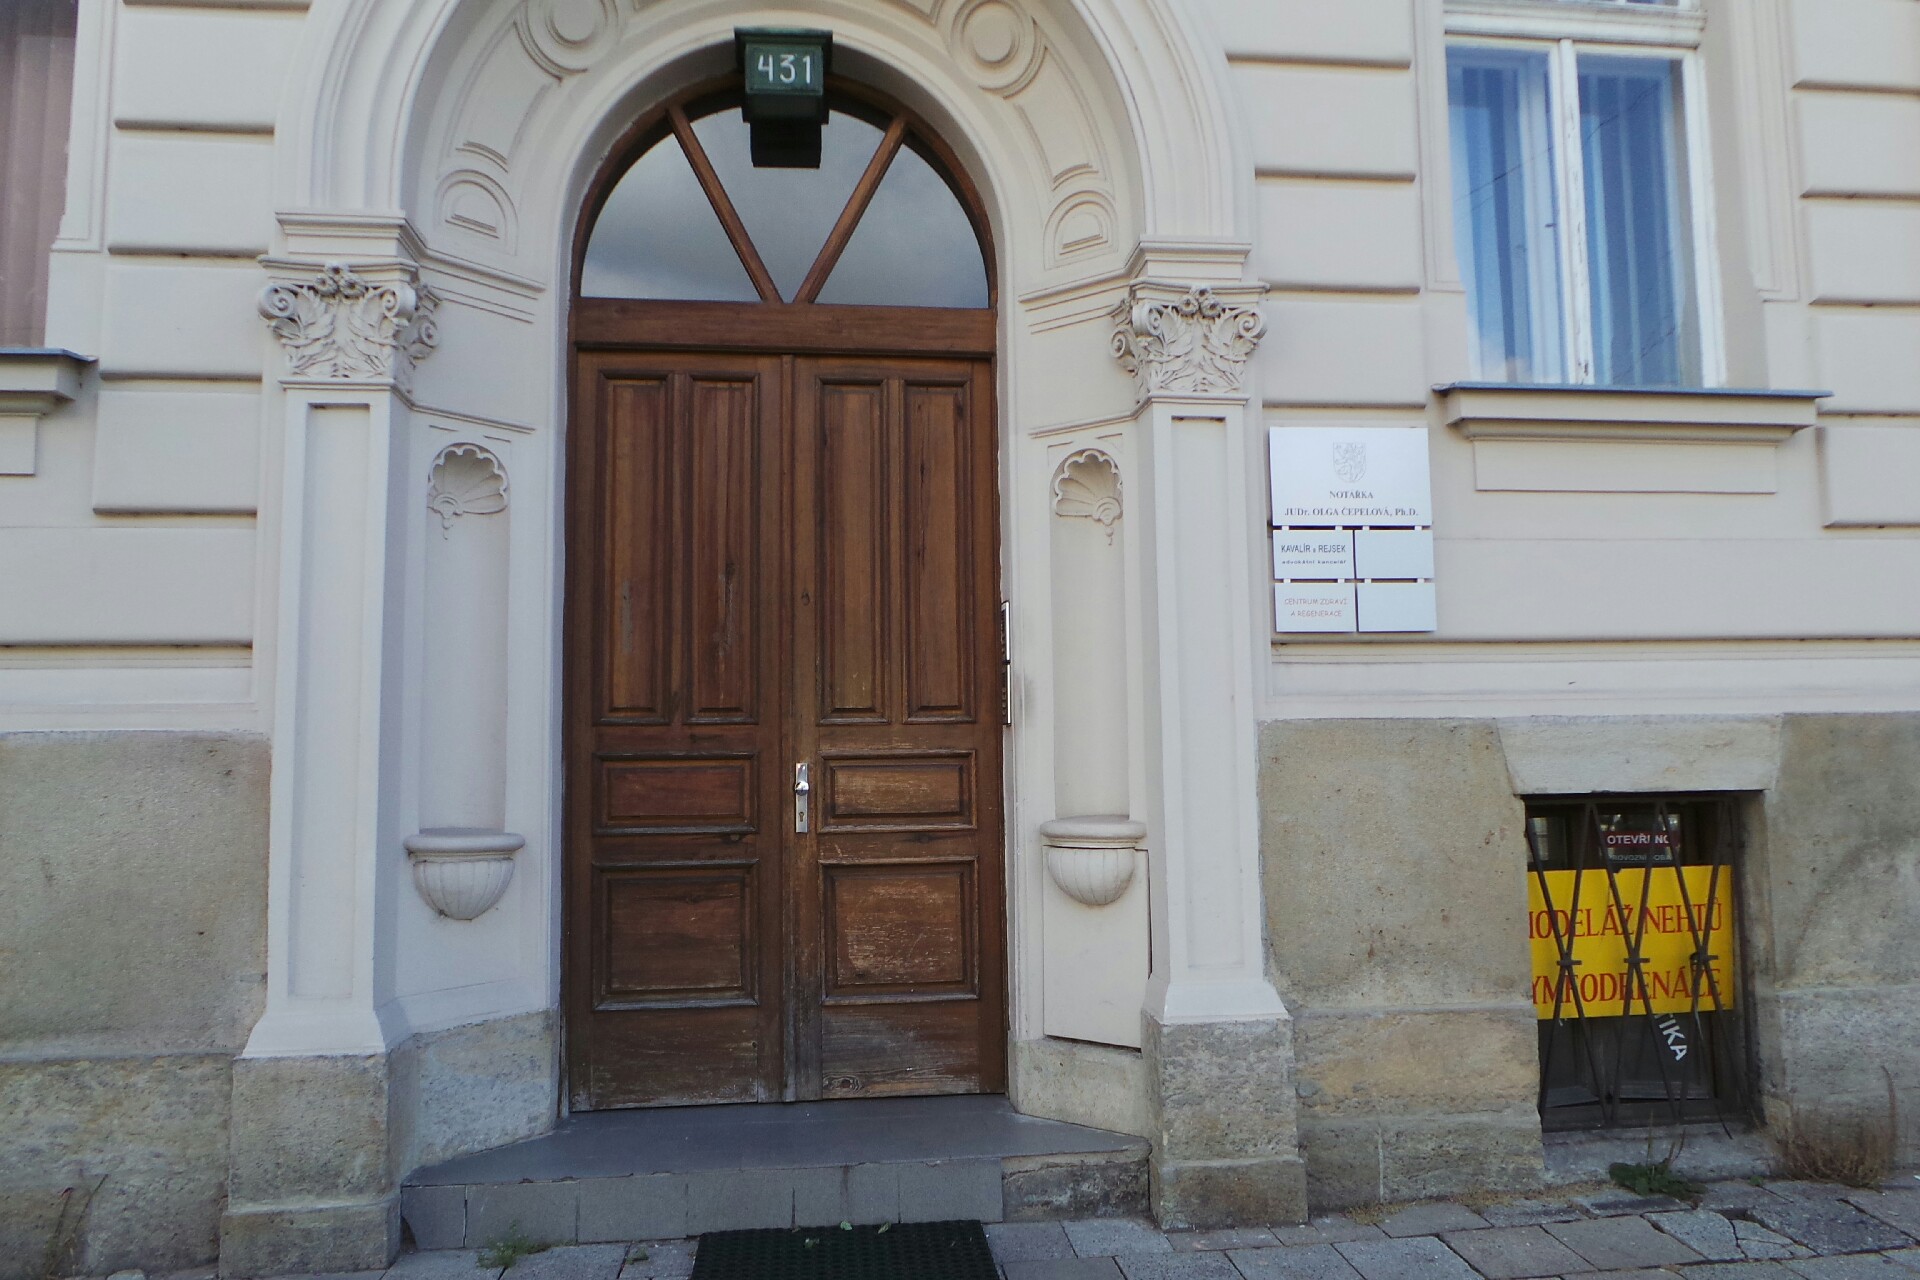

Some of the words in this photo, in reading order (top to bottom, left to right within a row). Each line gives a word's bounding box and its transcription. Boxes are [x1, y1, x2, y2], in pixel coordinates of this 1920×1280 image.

[757, 54, 811, 84] 431
[1312, 507, 1339, 516] OLGA
[1280, 543, 1311, 553] KAVALÍR
[1318, 544, 1346, 553] REJSEK
[1284, 598, 1318, 606] CENTRUM
[1528, 903, 1635, 939] ODELÁŽ
